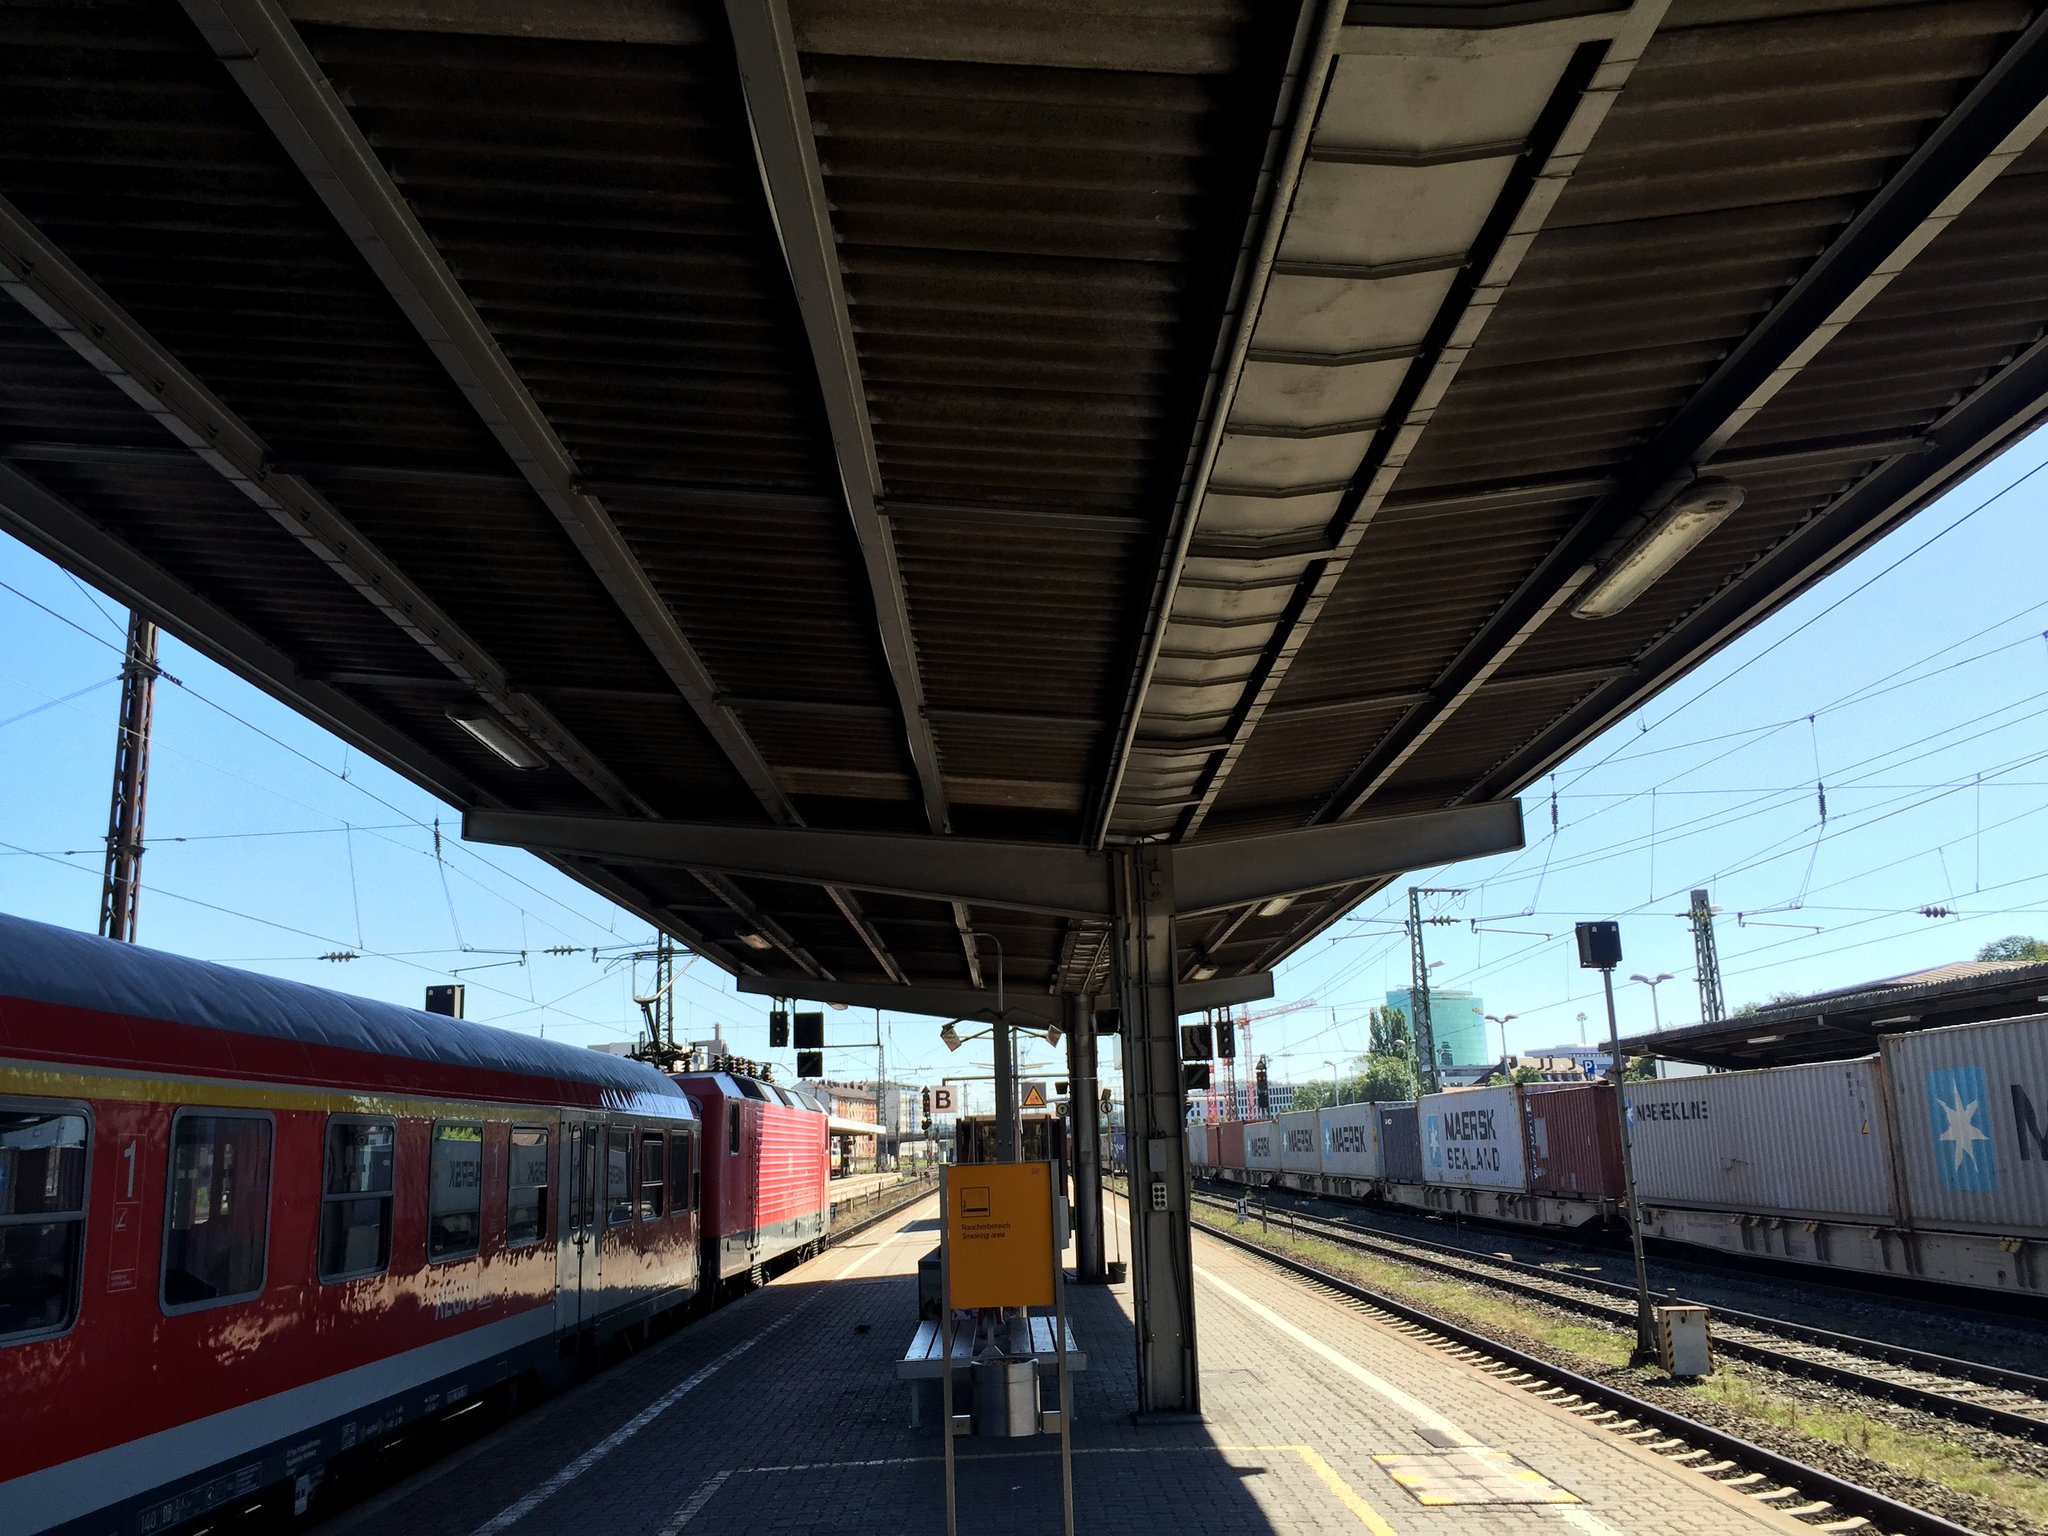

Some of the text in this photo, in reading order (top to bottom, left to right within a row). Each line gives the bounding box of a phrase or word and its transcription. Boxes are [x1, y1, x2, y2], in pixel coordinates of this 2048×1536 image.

[1584, 1061, 1593, 1073] P
[935, 1090, 951, 1109] B
[1444, 1109, 1497, 1141] MAERSK
[1287, 1129, 1315, 1153] MAERSK
[1331, 1125, 1367, 1153] MAERSK
[123, 1139, 137, 1198] 1
[1237, 1200, 1247, 1214] H
[961, 1222, 1011, 1231] Raucherbereich
